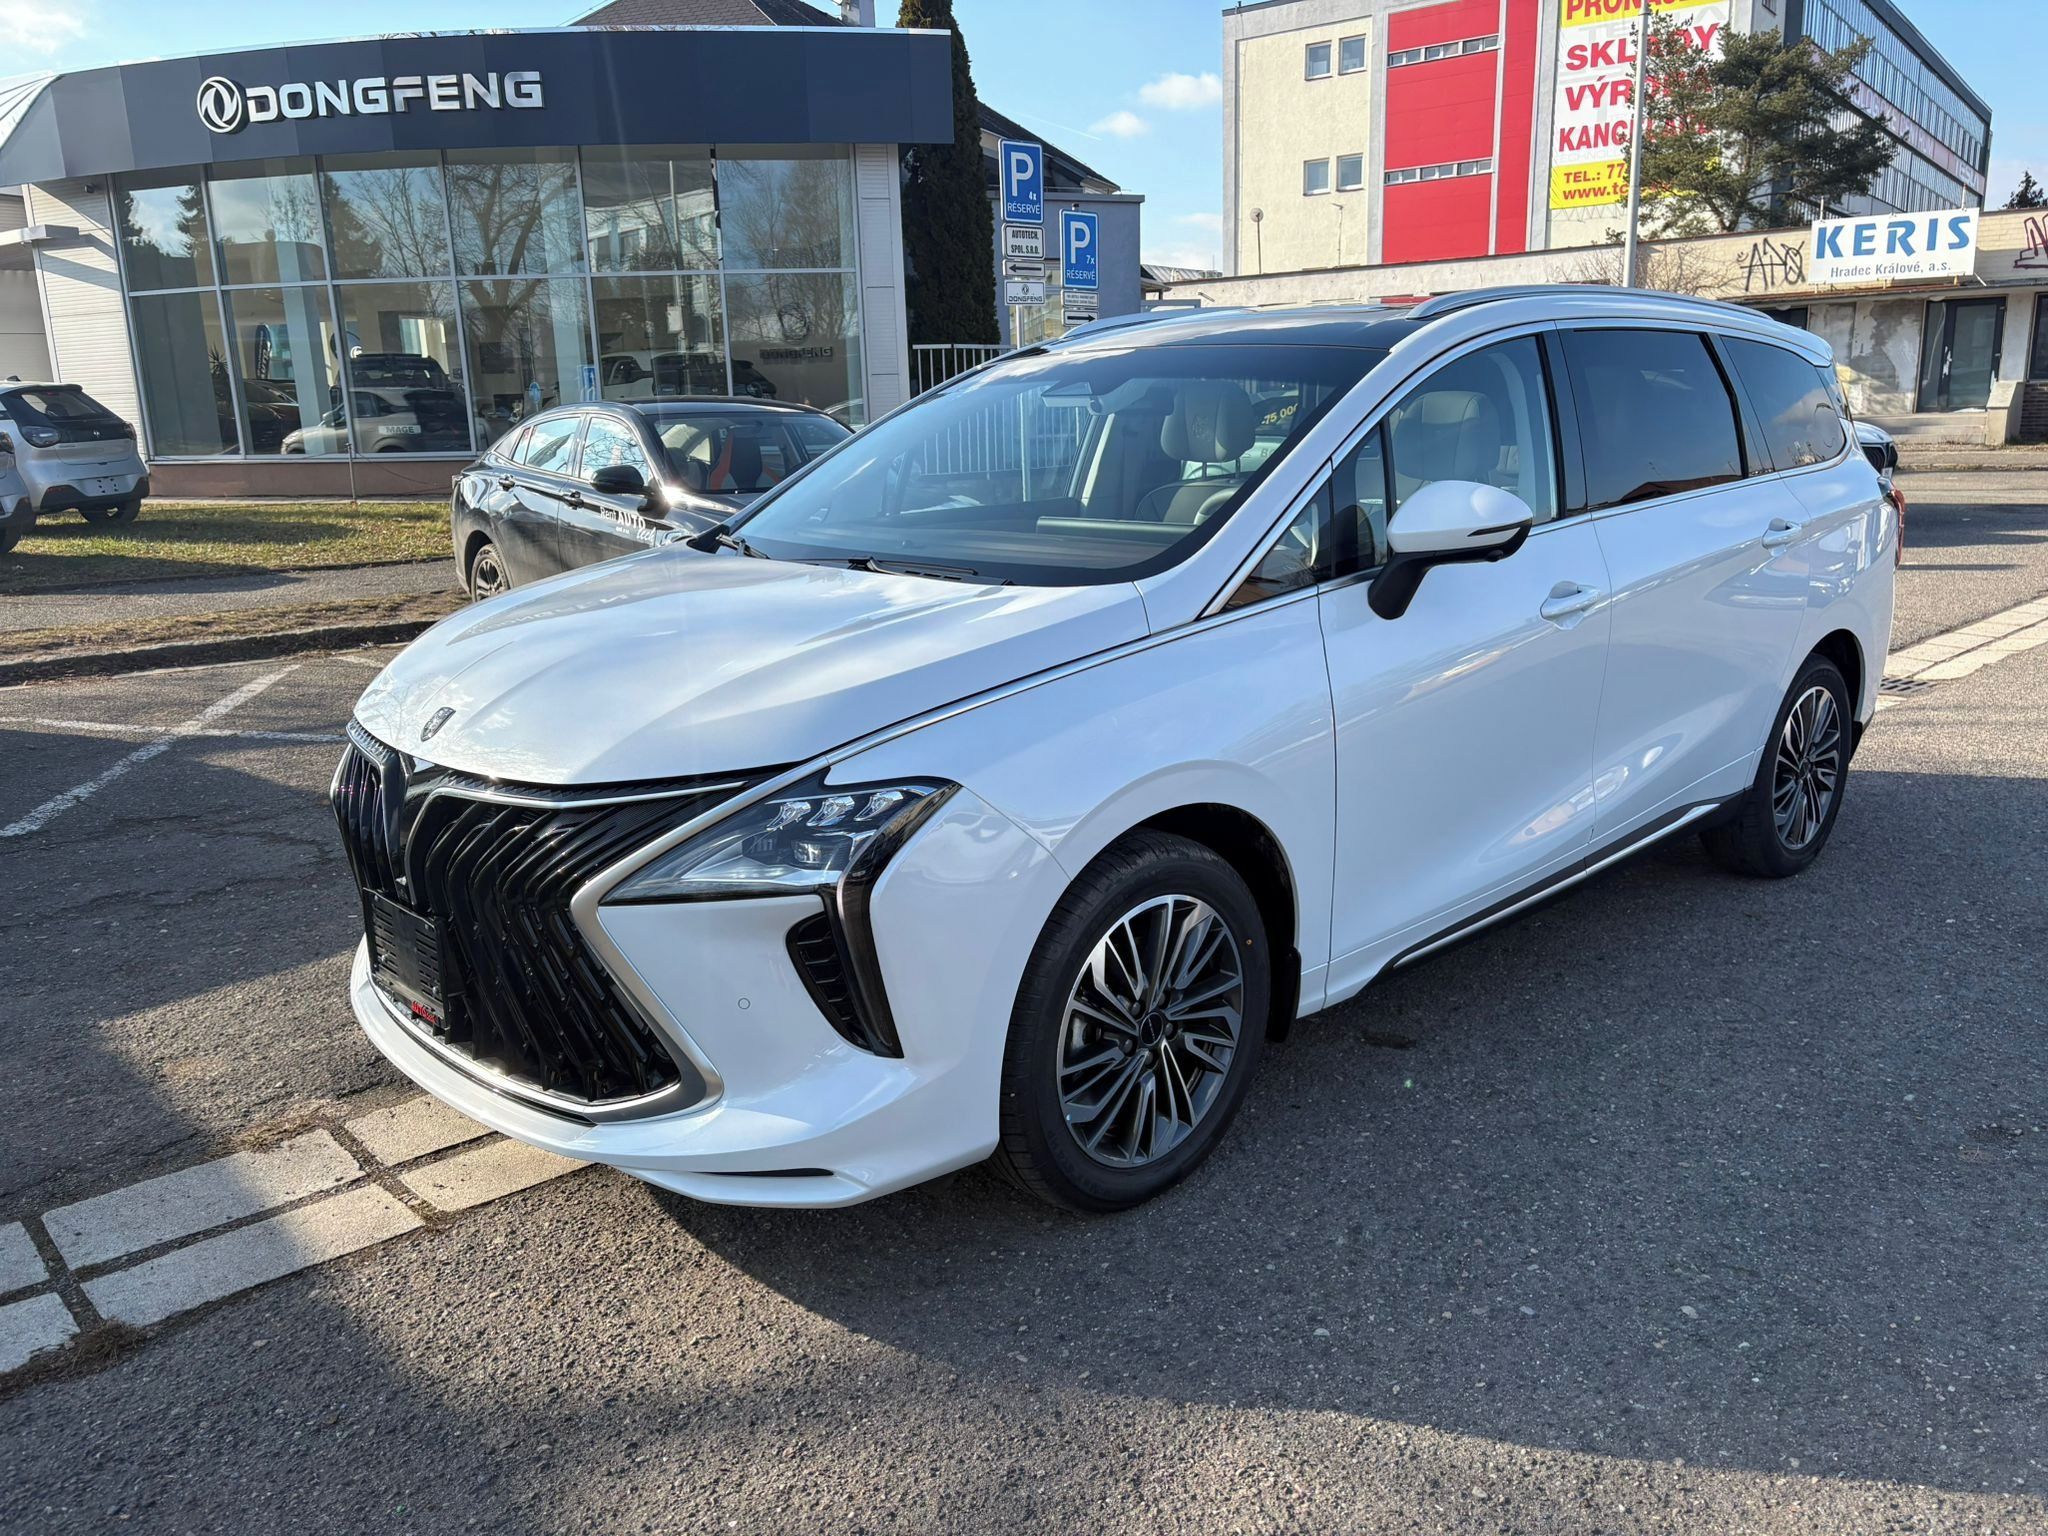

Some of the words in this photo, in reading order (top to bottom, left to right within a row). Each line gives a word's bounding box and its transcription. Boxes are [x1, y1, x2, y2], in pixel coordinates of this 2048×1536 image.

[1566, 23, 1720, 71] SKLDY
[245, 71, 544, 123] DONGFENG
[1010, 151, 1034, 197] P
[1563, 170, 1600, 184] TEL.:
[1606, 162, 1626, 180] 77
[1028, 191, 1037, 200] 4x
[1562, 181, 1630, 201] www.tc
[1007, 200, 1040, 215] RÉSERVÉ
[1070, 221, 1091, 265] P
[1816, 215, 1971, 259] KERIS
[1086, 254, 1095, 265] 7x
[1830, 265, 1871, 278] Hradec
[1875, 260, 1925, 275] Králové,
[1928, 261, 1951, 272] a.s.
[1066, 266, 1096, 281] RÉSERVÉ
[600, 506, 617, 521] Rent
[617, 510, 646, 529] AUTO
